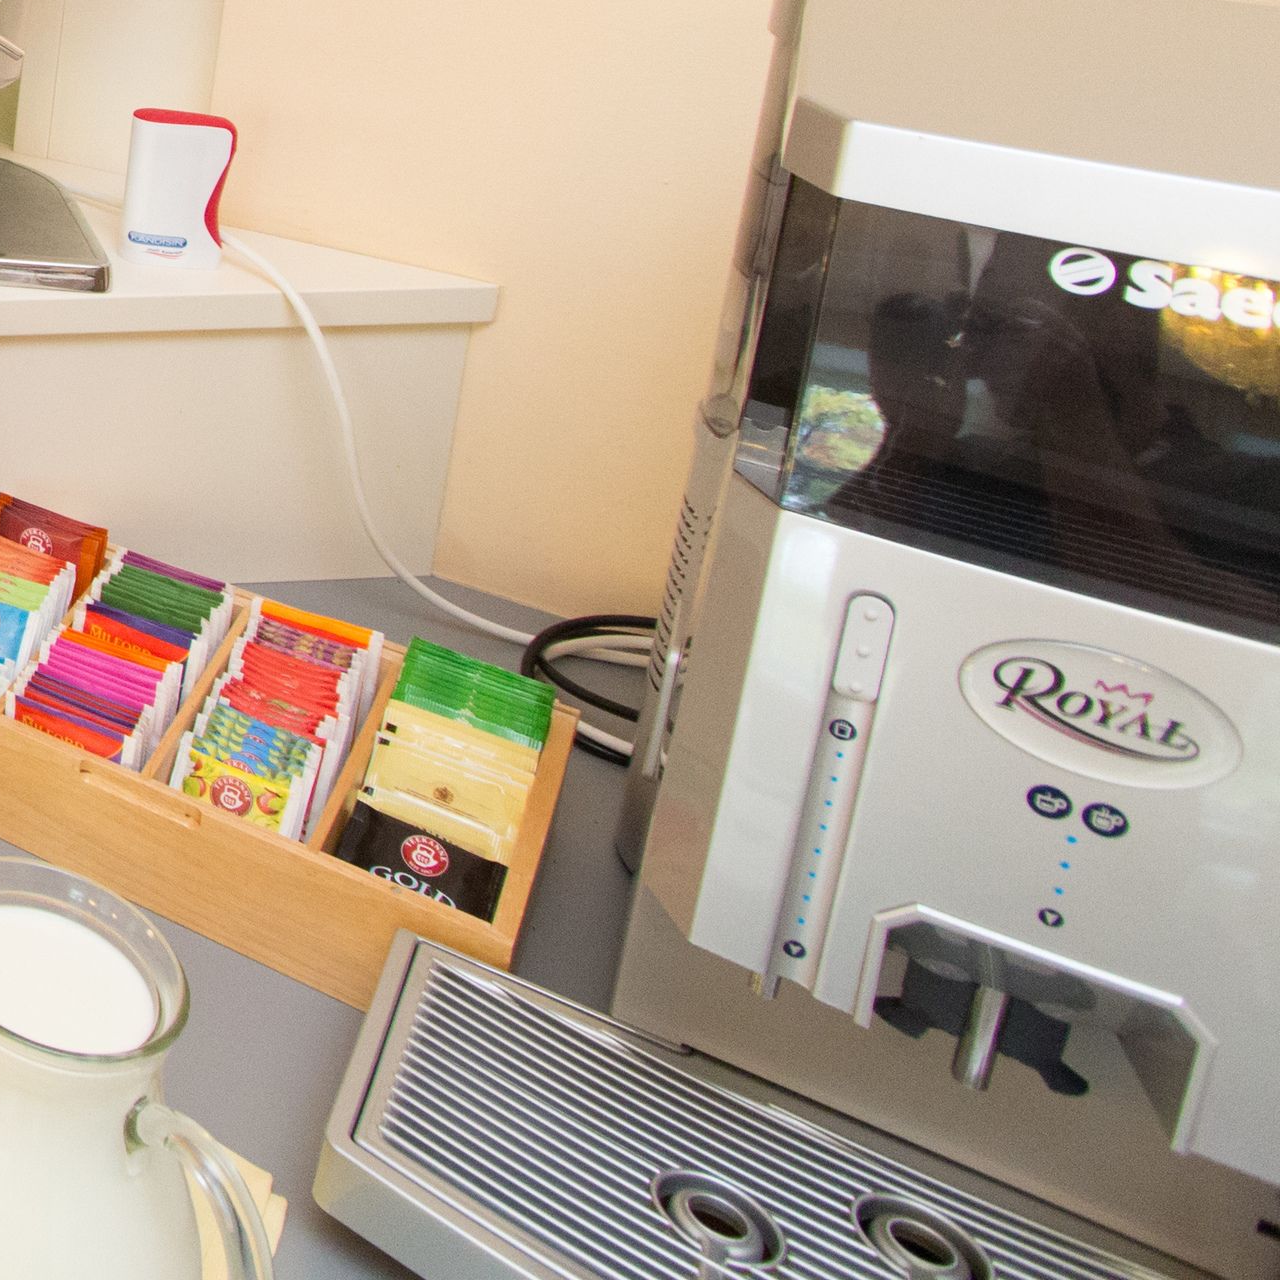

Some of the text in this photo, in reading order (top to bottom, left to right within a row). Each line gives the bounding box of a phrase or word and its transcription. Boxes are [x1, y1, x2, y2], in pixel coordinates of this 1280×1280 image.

[1122, 259, 1280, 330] Sae
[213, 777, 251, 801] TEEKANNE
[405, 837, 448, 862] TEEKANNE
[369, 865, 457, 908] GOLD
